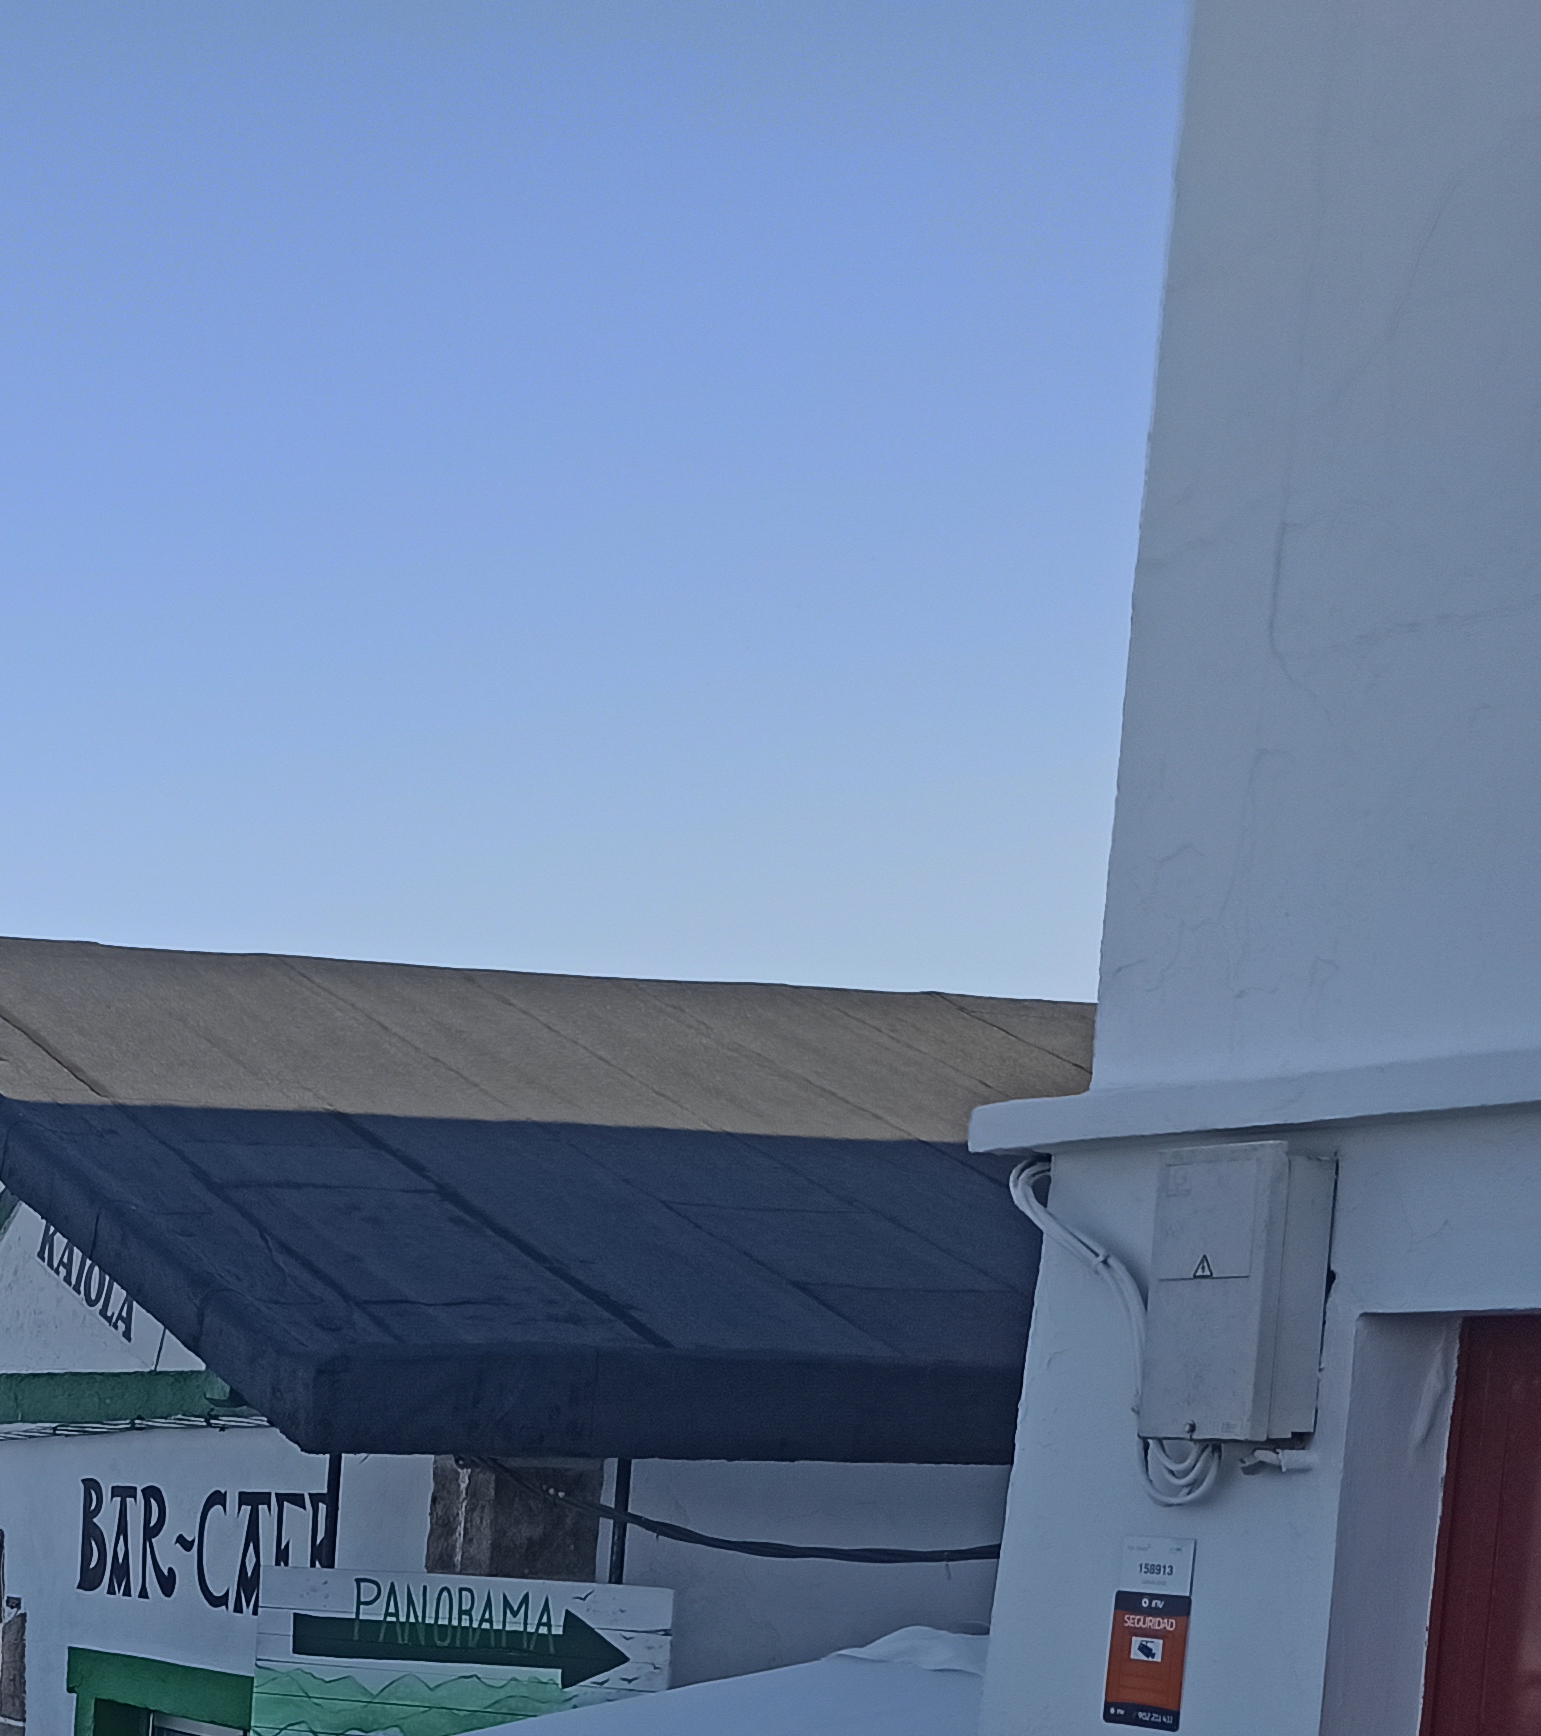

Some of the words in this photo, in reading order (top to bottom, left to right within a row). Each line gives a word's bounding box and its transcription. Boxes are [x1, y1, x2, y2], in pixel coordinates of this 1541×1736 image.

[37, 1221, 134, 1343] KAIOLA
[1139, 1562, 1174, 1576] 158913
[353, 1577, 557, 1655] PANORAMA
[1123, 1614, 1176, 1631] SEGURIDAD
